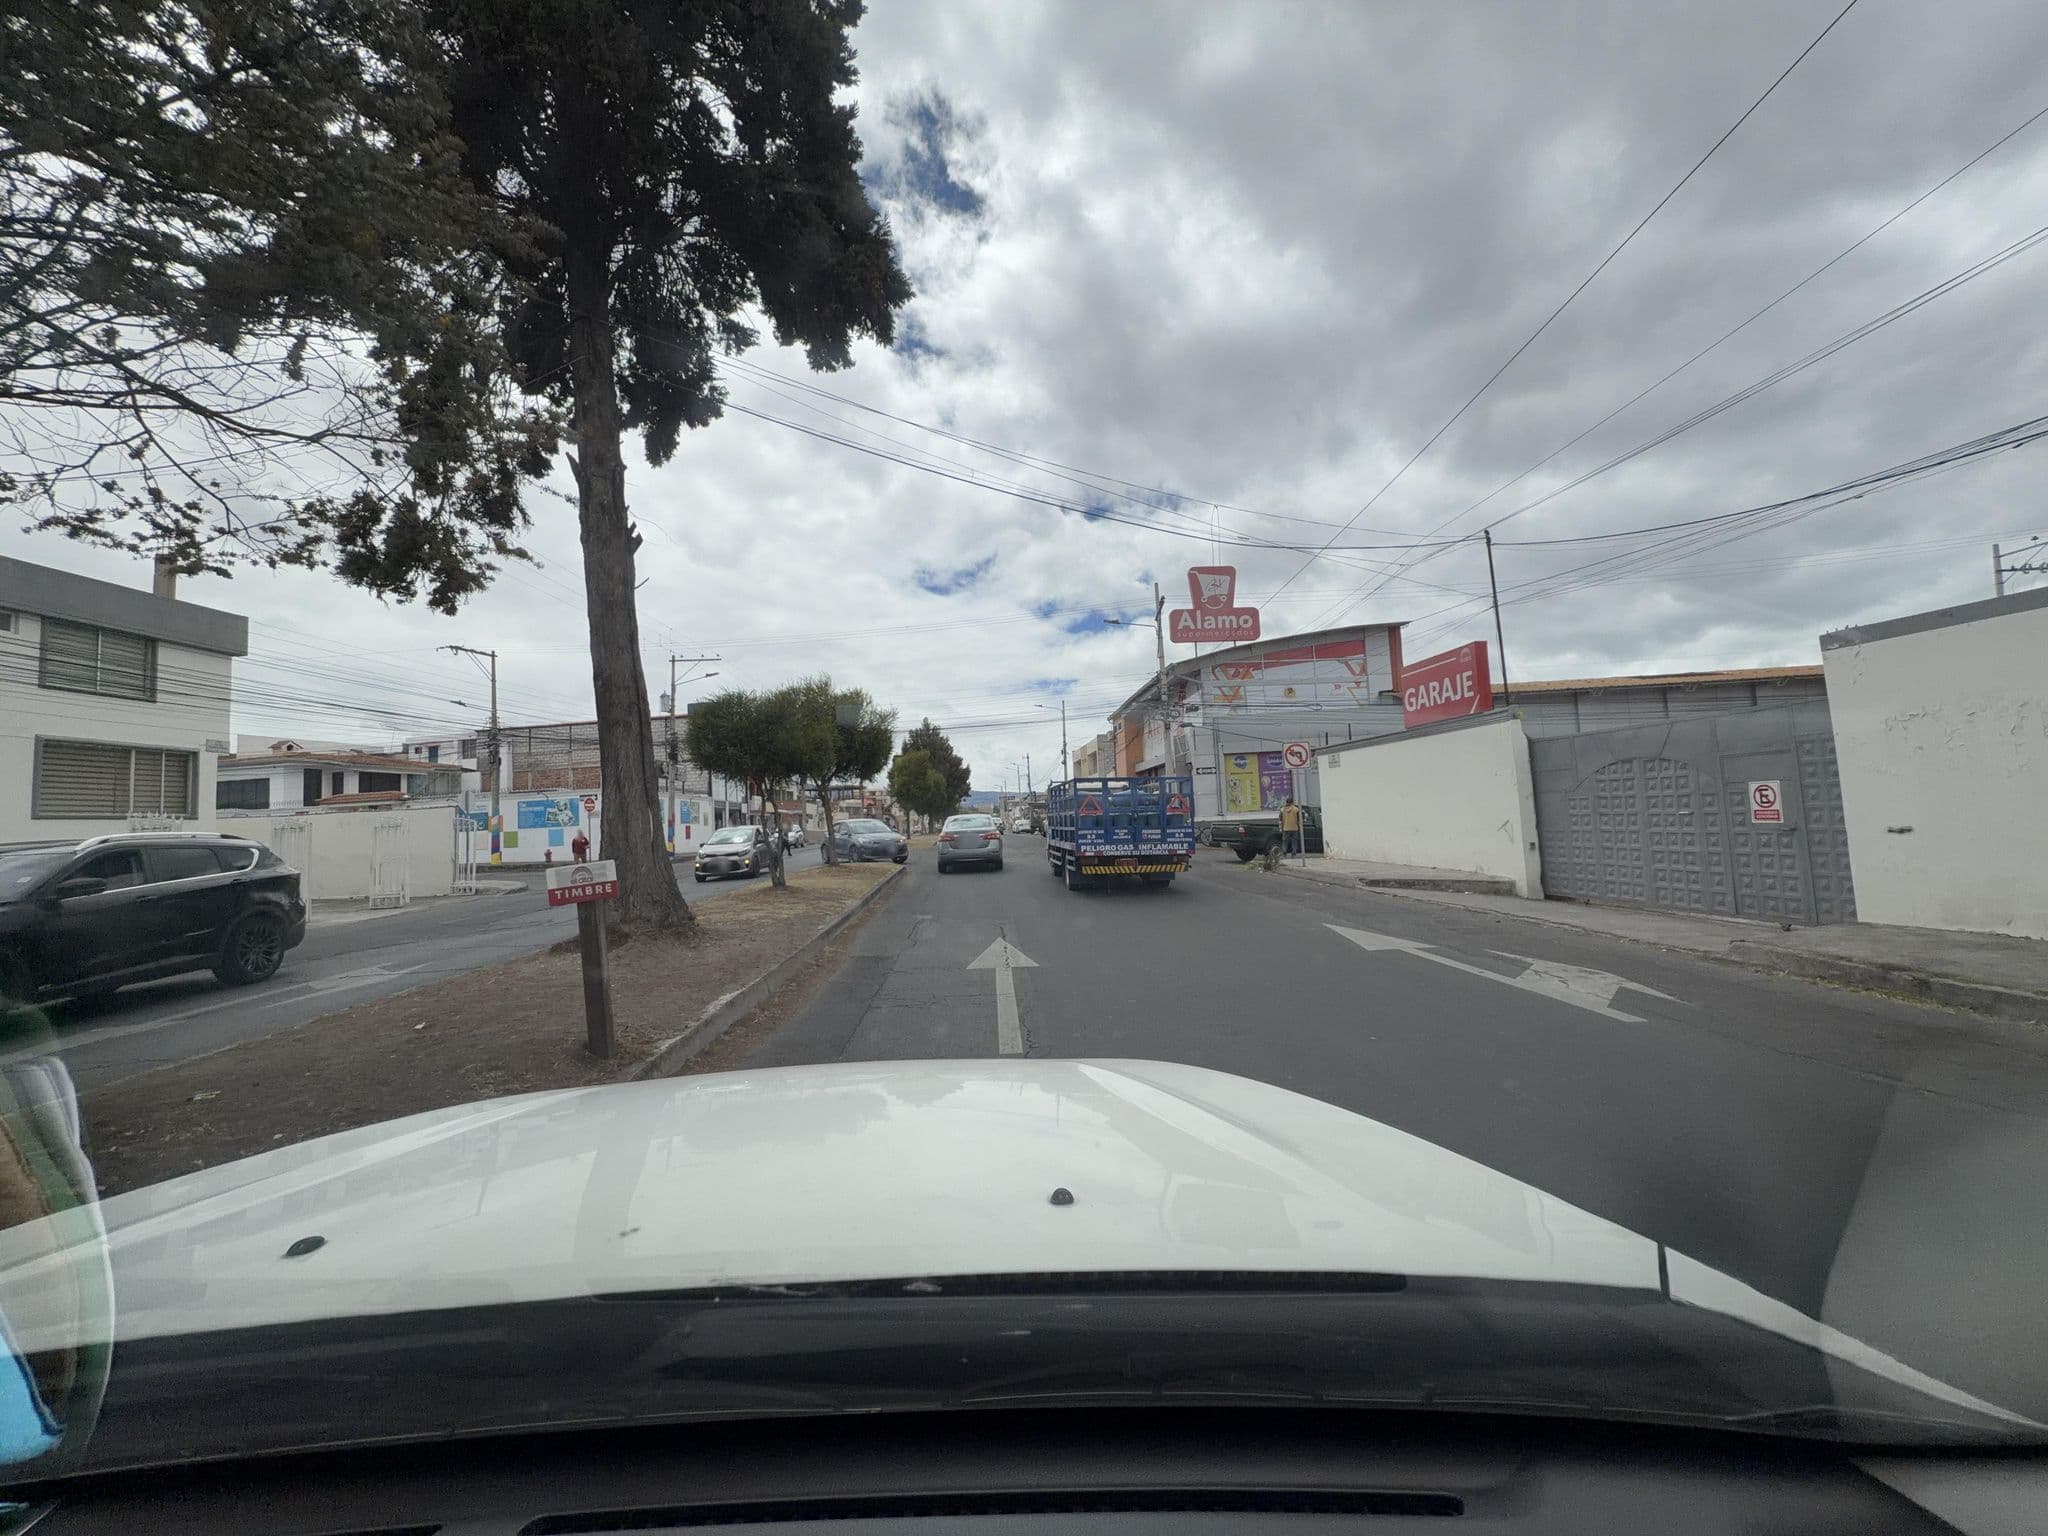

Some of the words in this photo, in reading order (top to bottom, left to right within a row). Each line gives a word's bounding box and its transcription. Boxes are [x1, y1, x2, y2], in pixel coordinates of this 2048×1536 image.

[1177, 610, 1253, 630] Alamo
[1404, 670, 1475, 712] GARAJE
[555, 883, 612, 900] TIMBRE
